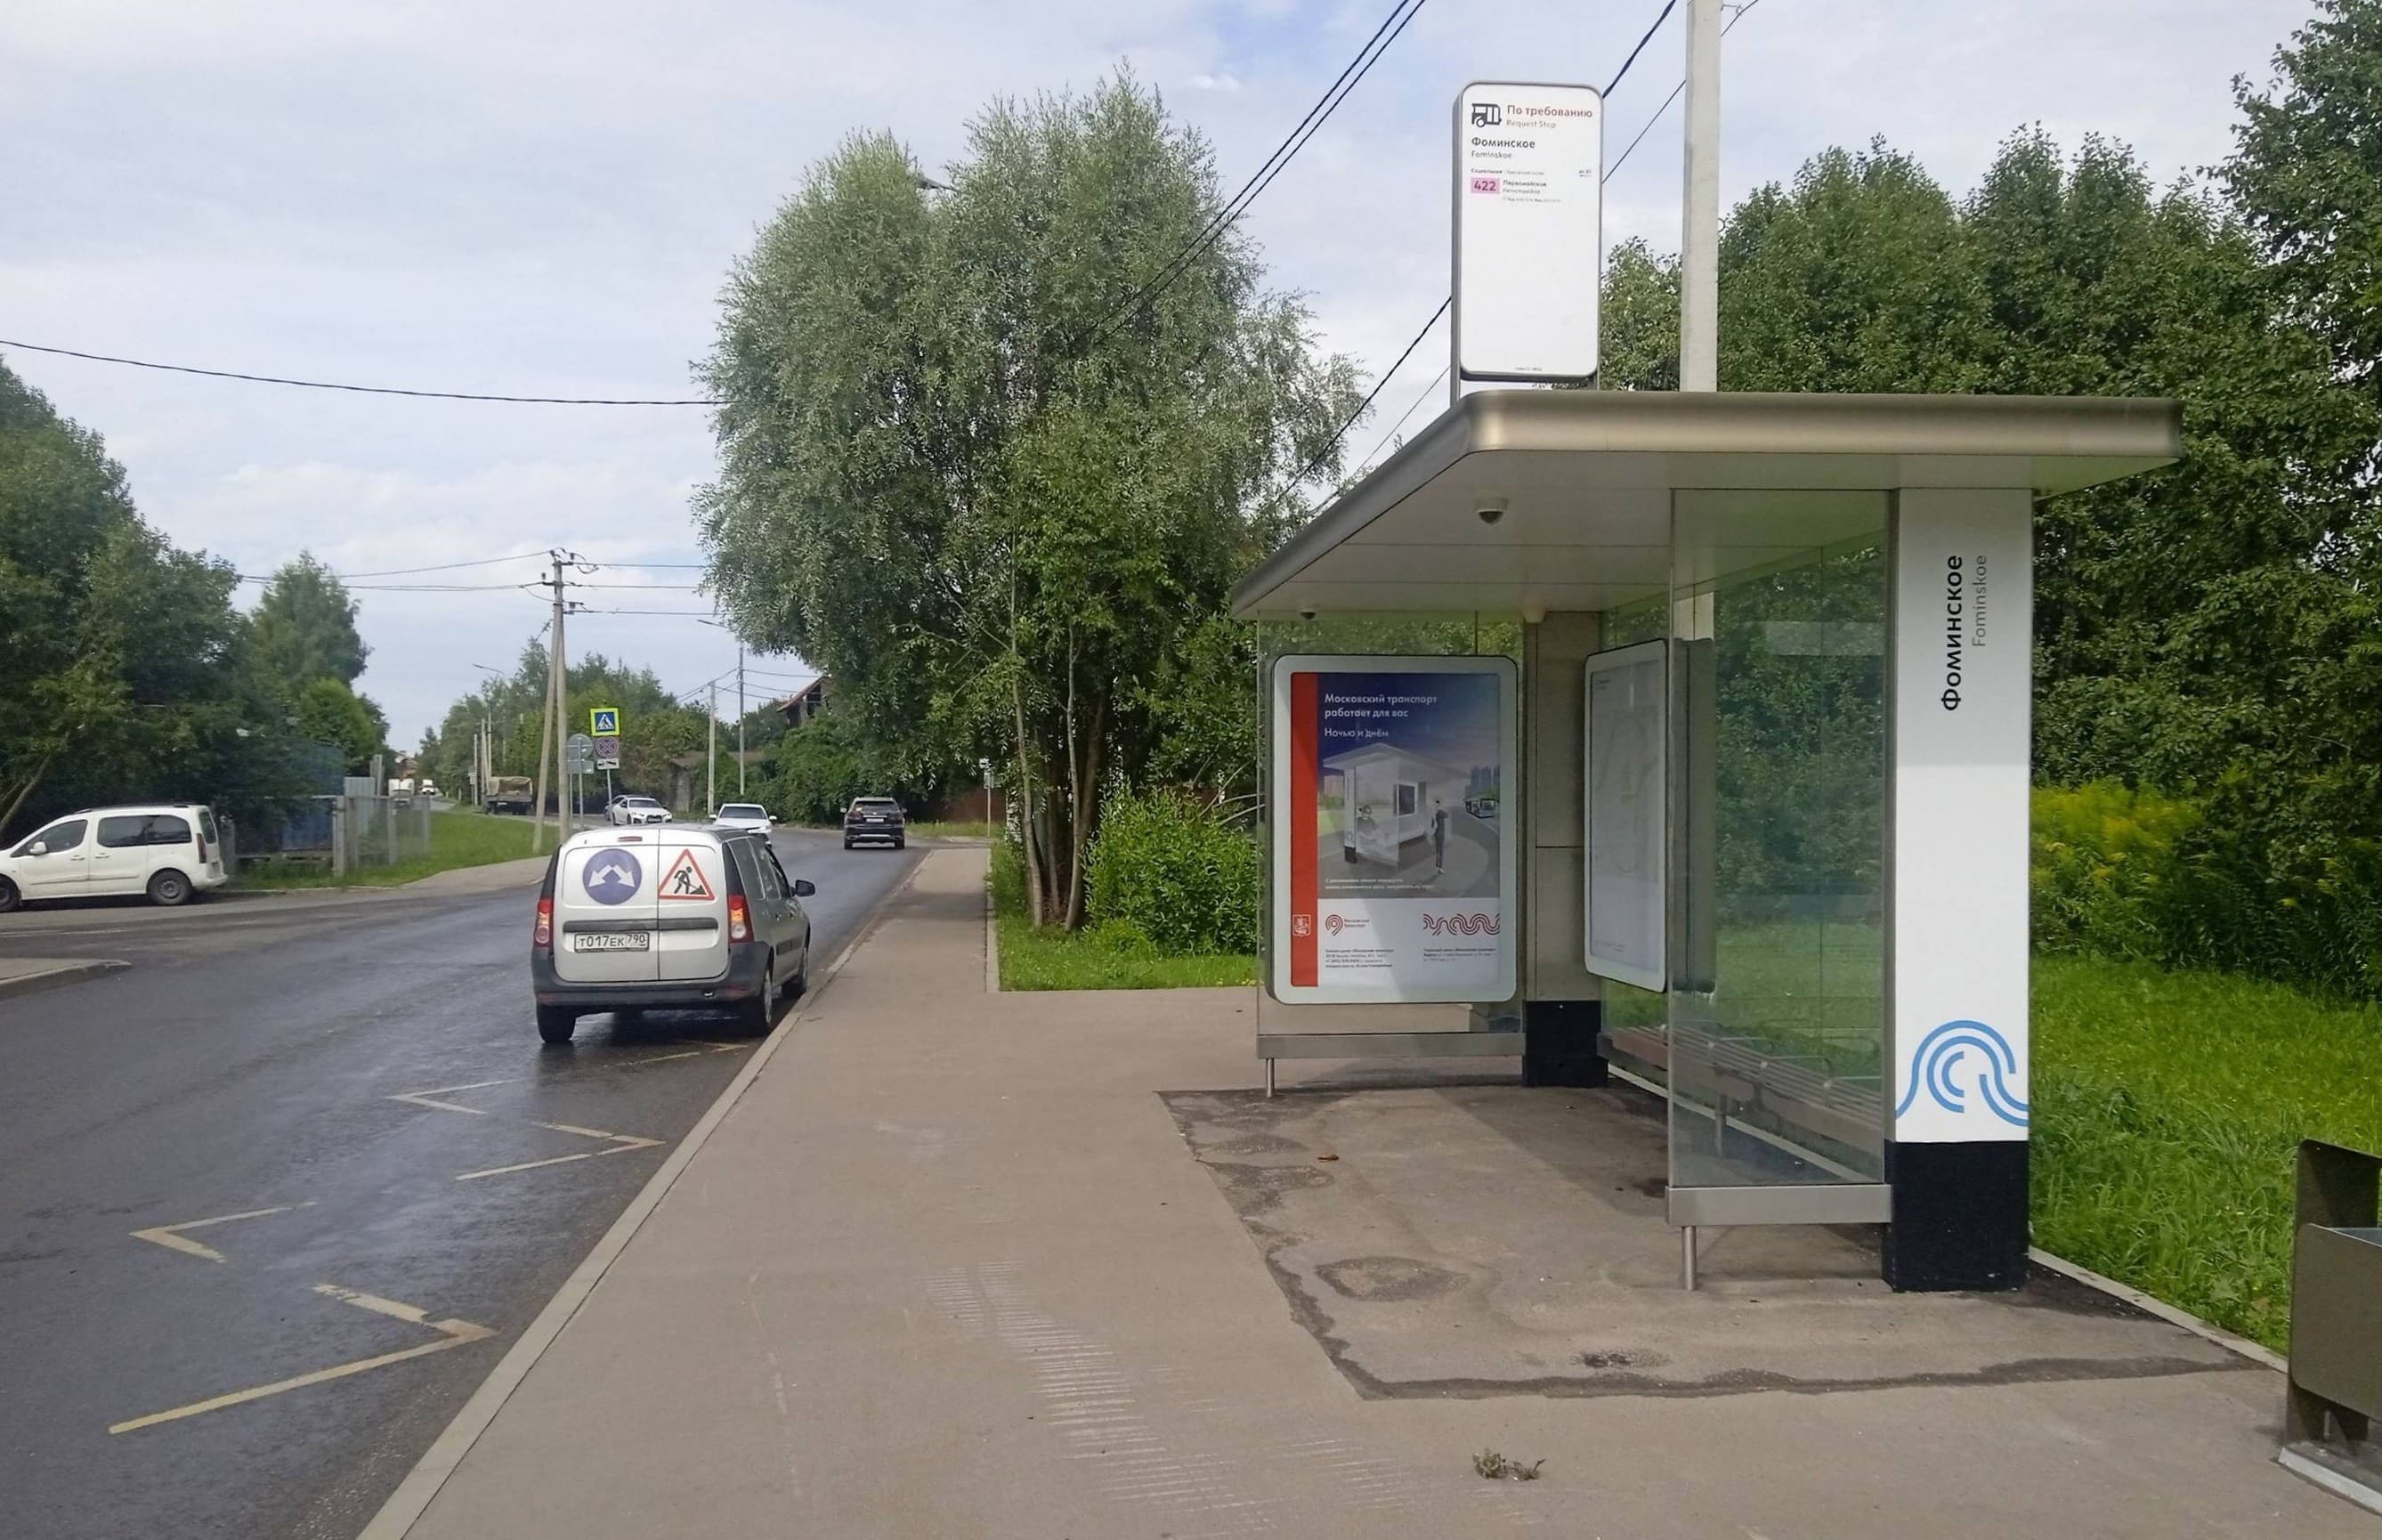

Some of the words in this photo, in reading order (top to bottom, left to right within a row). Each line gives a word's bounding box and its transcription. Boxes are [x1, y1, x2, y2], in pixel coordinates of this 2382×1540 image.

[1507, 105, 1522, 115] По
[1526, 107, 1593, 118] требованию
[1539, 121, 1557, 129] Stop
[1471, 137, 1535, 149] Фоминское
[1471, 150, 1512, 158] Fominskoe
[1474, 181, 1496, 191] 422
[1973, 555, 1987, 647] Fominskoe
[1940, 555, 1963, 711] Фоминское
[1325, 693, 1385, 703] Московский
[1388, 696, 1438, 706] транспорт
[1325, 707, 1371, 719] работает
[1325, 727, 1355, 737] Ночью
